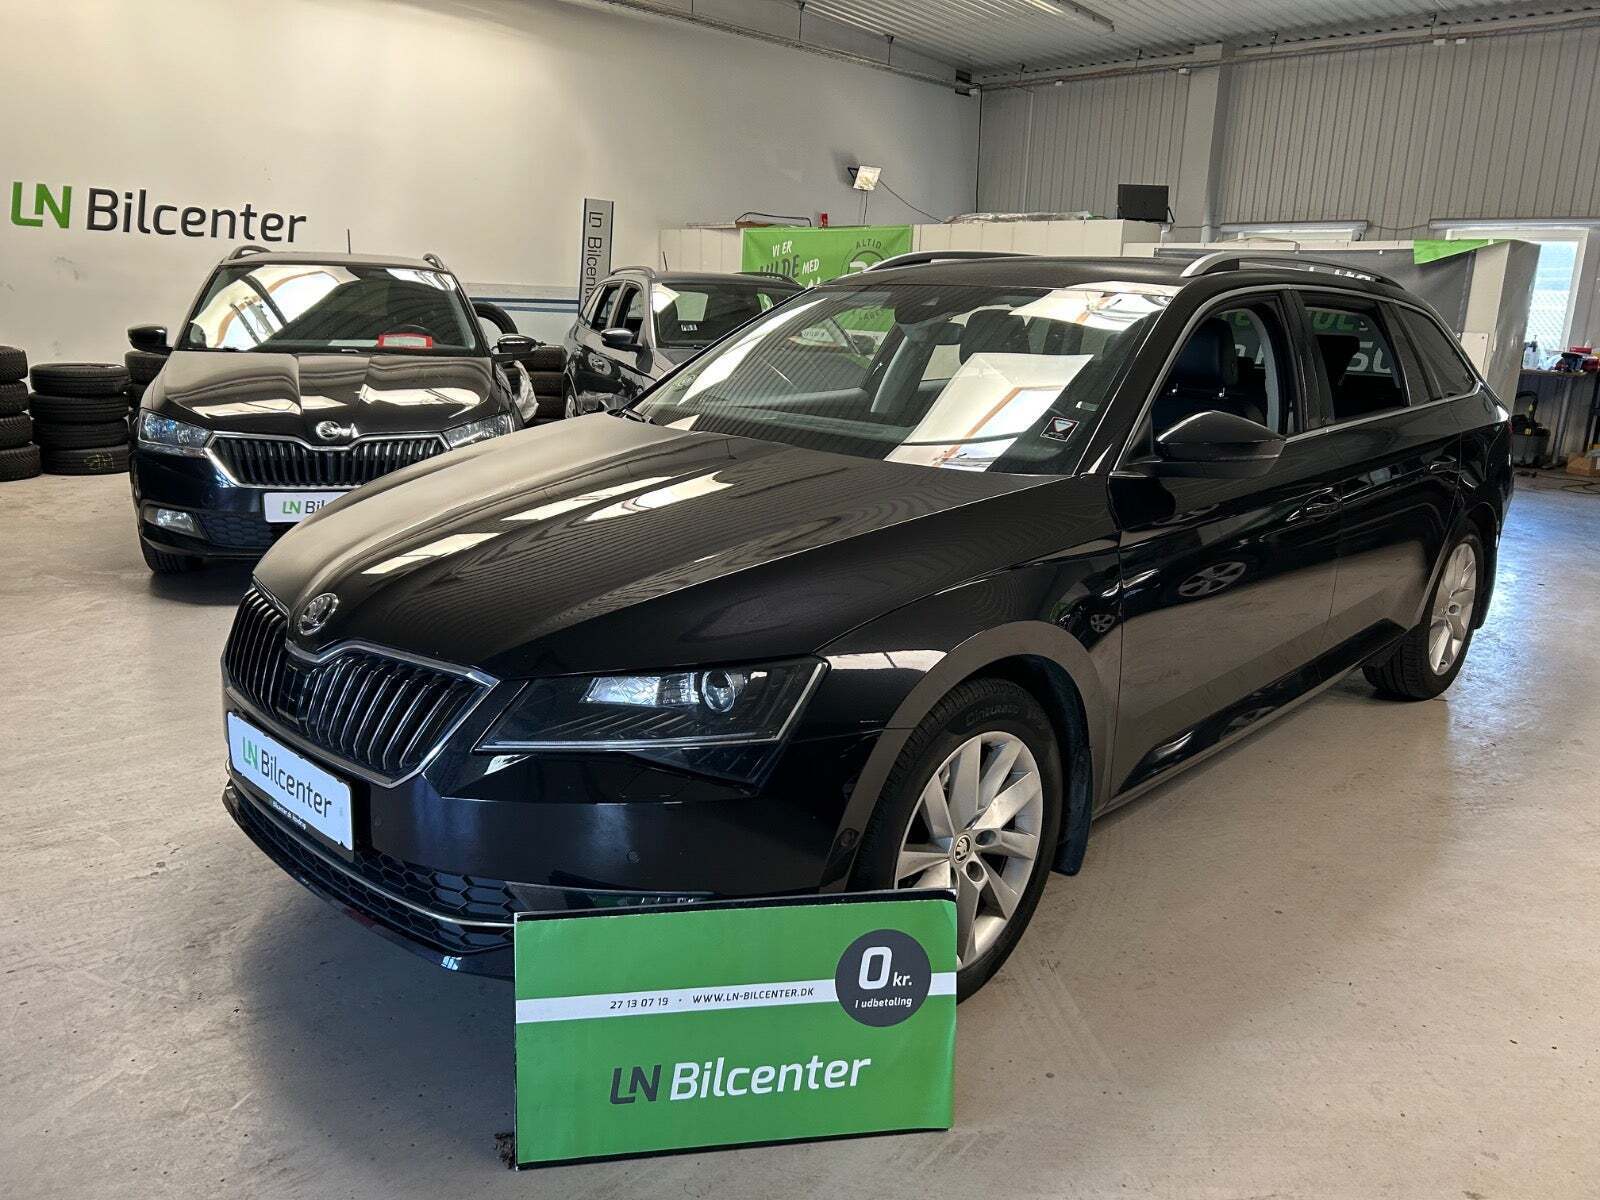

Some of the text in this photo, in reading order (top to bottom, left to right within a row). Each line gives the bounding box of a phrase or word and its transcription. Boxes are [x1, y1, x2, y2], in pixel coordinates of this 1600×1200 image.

[11, 181, 307, 243] LN Bilcenter
[772, 240, 793, 257] VI ER
[856, 238, 882, 250] ALTID
[802, 258, 820, 275] MED
[282, 501, 300, 514] LN
[242, 735, 259, 770] LN
[261, 748, 333, 819] Bilcenter
[858, 946, 913, 990] 0 kr.
[609, 987, 814, 1010] 27 13 07 19 WWW.LN-BILCENTER.DK
[861, 996, 913, 1008] udbetaling
[609, 1054, 872, 1105] LN Bilcenter
